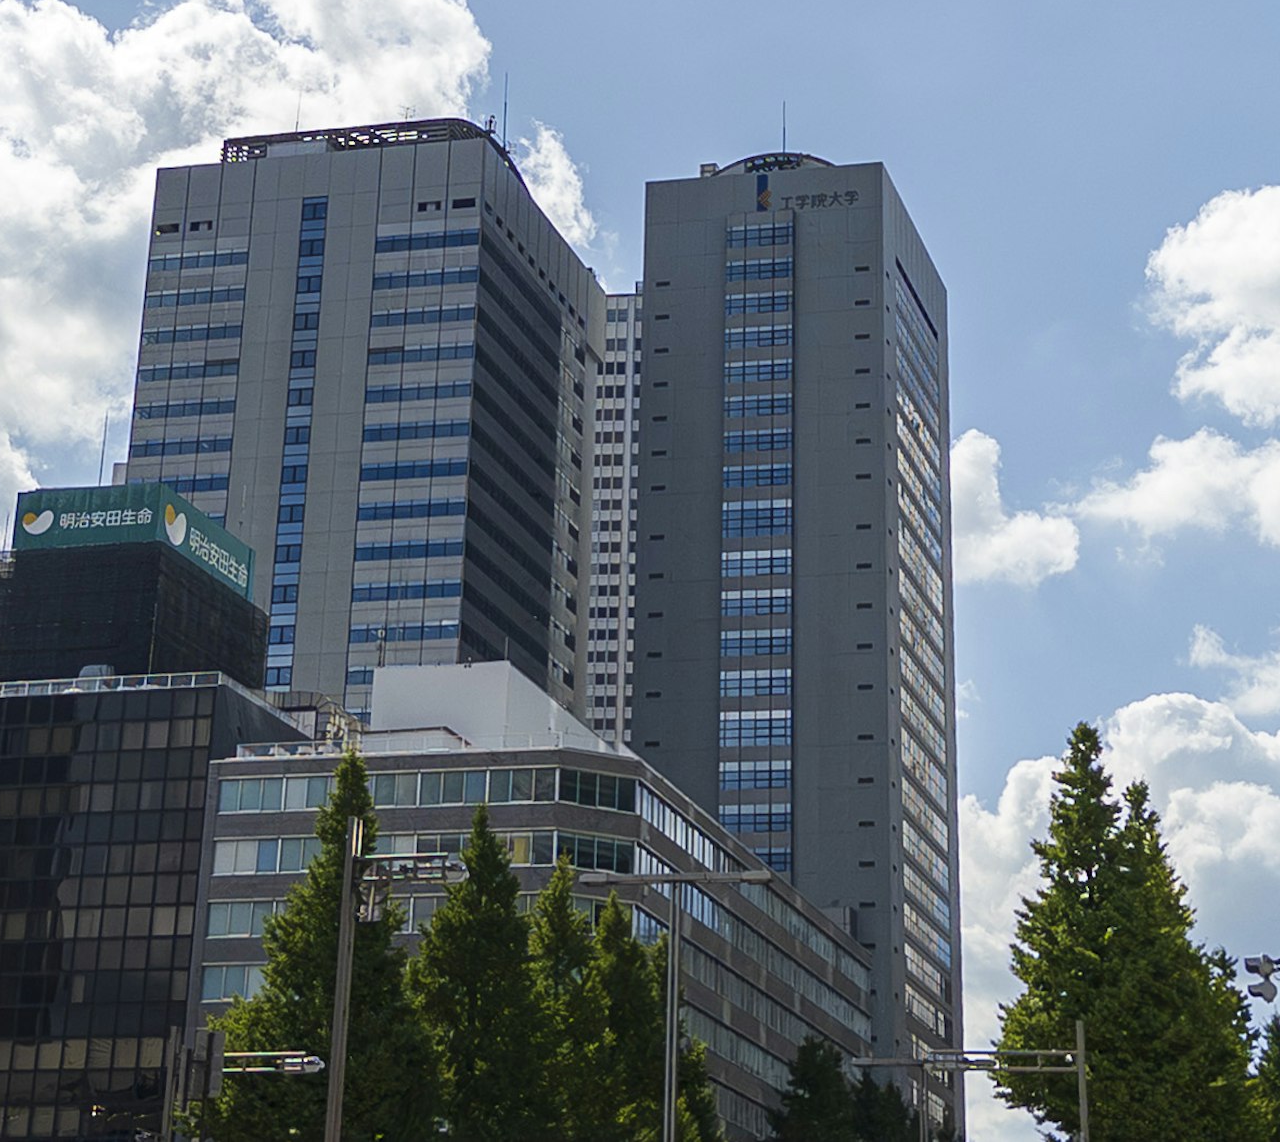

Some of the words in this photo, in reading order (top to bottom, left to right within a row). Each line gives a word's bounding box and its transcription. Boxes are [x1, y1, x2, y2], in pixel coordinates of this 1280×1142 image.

[780, 190, 859, 210] 工学院大学
[59, 507, 153, 529] 明治安田生命
[189, 527, 249, 588] 明治安田生命
